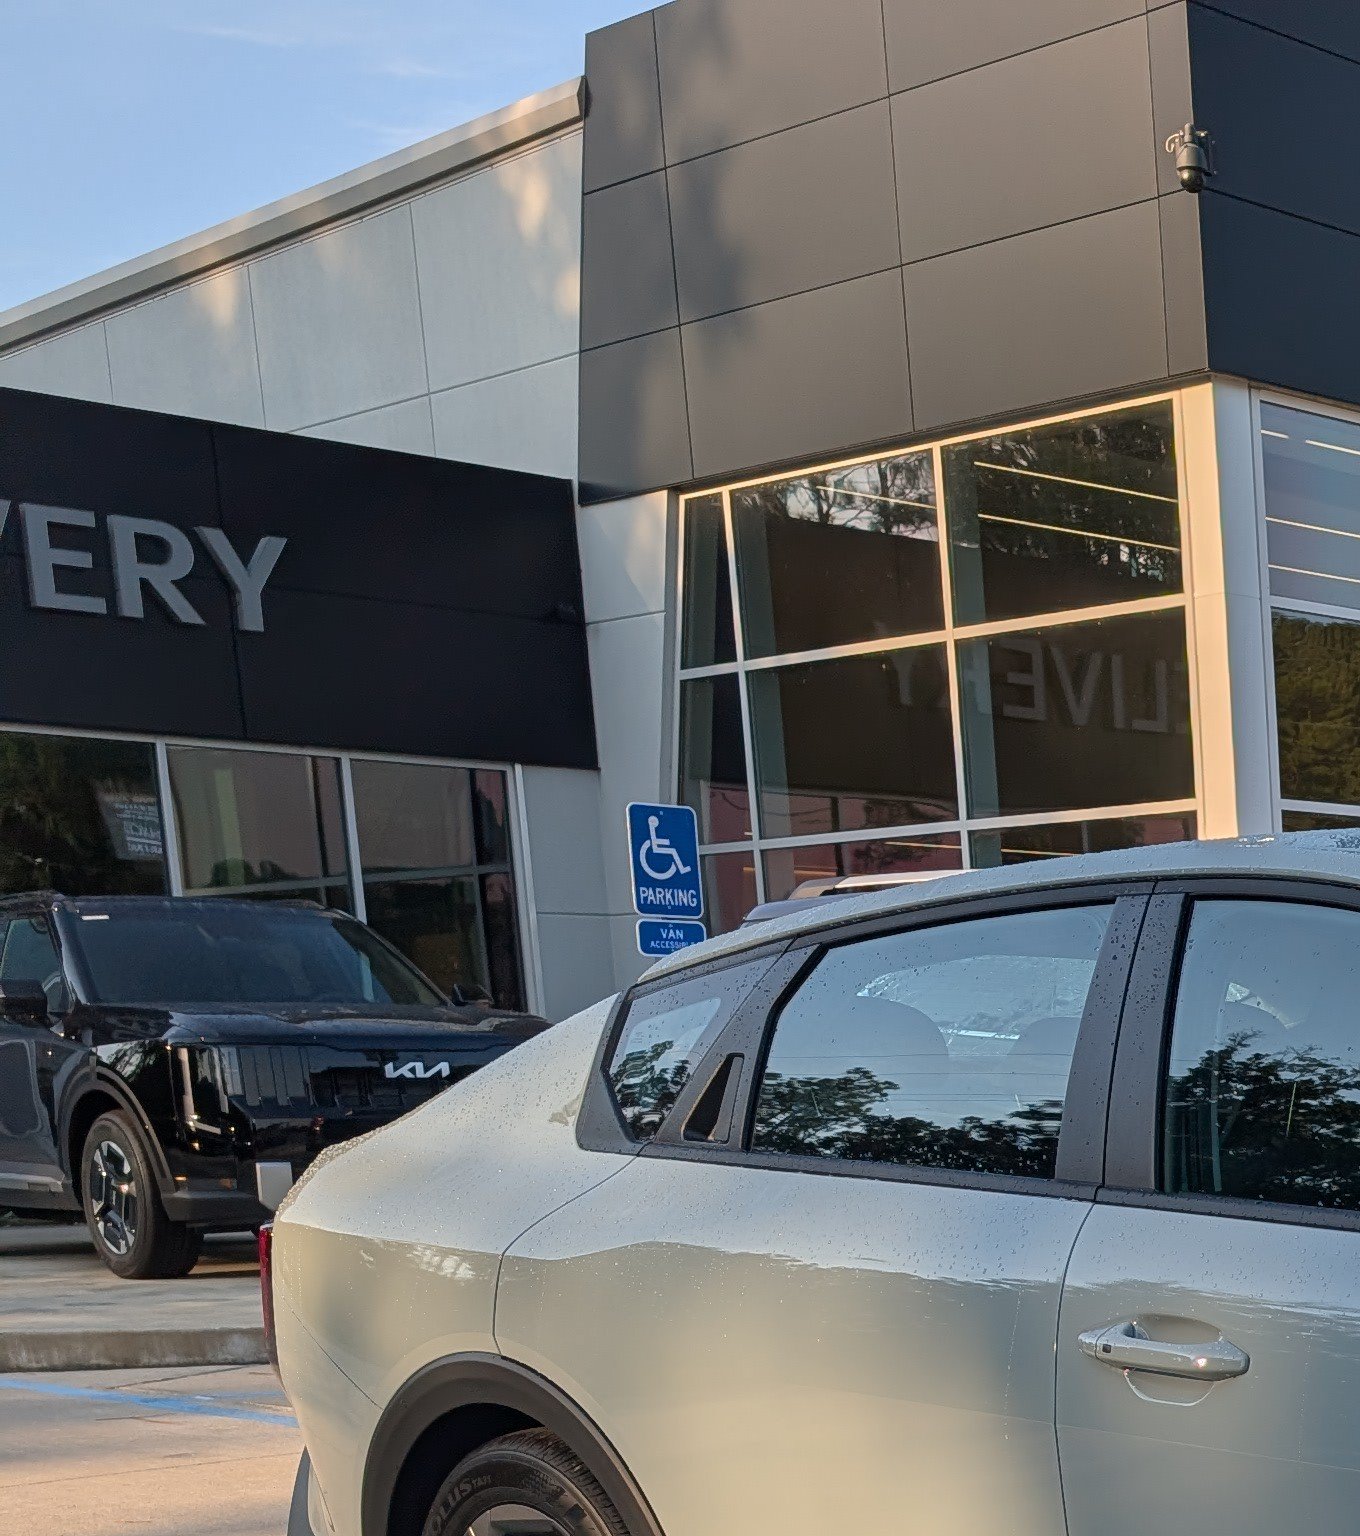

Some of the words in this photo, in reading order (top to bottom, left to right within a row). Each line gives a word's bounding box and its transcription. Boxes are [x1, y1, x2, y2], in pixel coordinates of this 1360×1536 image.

[0, 499, 288, 632] ERY
[639, 886, 698, 908] PARKING
[659, 928, 684, 940] VAN
[650, 941, 695, 950] ACCESSIB
[384, 1061, 451, 1078] KIA
